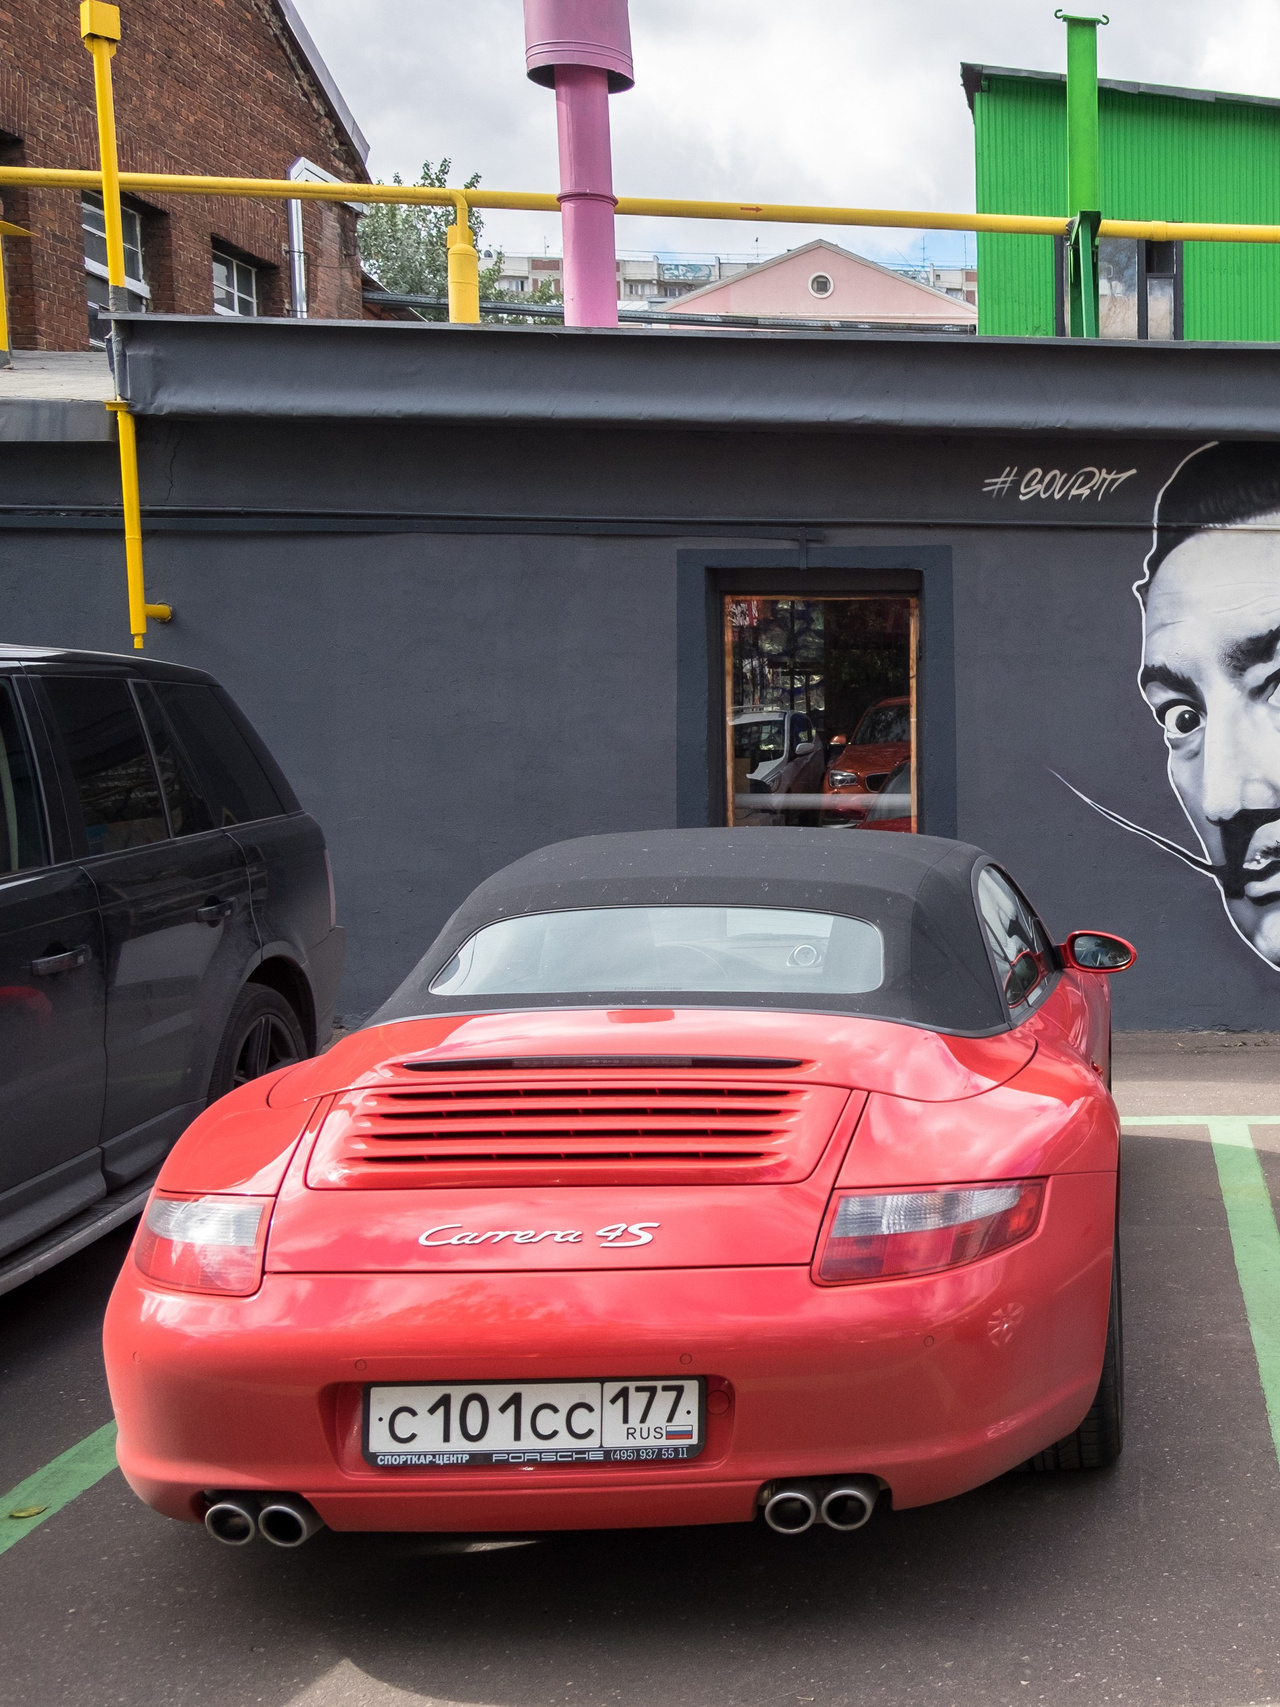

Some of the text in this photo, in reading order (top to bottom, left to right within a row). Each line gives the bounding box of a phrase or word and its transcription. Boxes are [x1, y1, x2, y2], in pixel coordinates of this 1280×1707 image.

[418, 1222, 661, 1248] Carrera 4S
[609, 1384, 686, 1425] 177
[626, 1426, 664, 1441] RUS
[377, 1447, 688, 1466] СПОРТКАР-ЦЕНТР PORSCHE (495) 937 55 11
